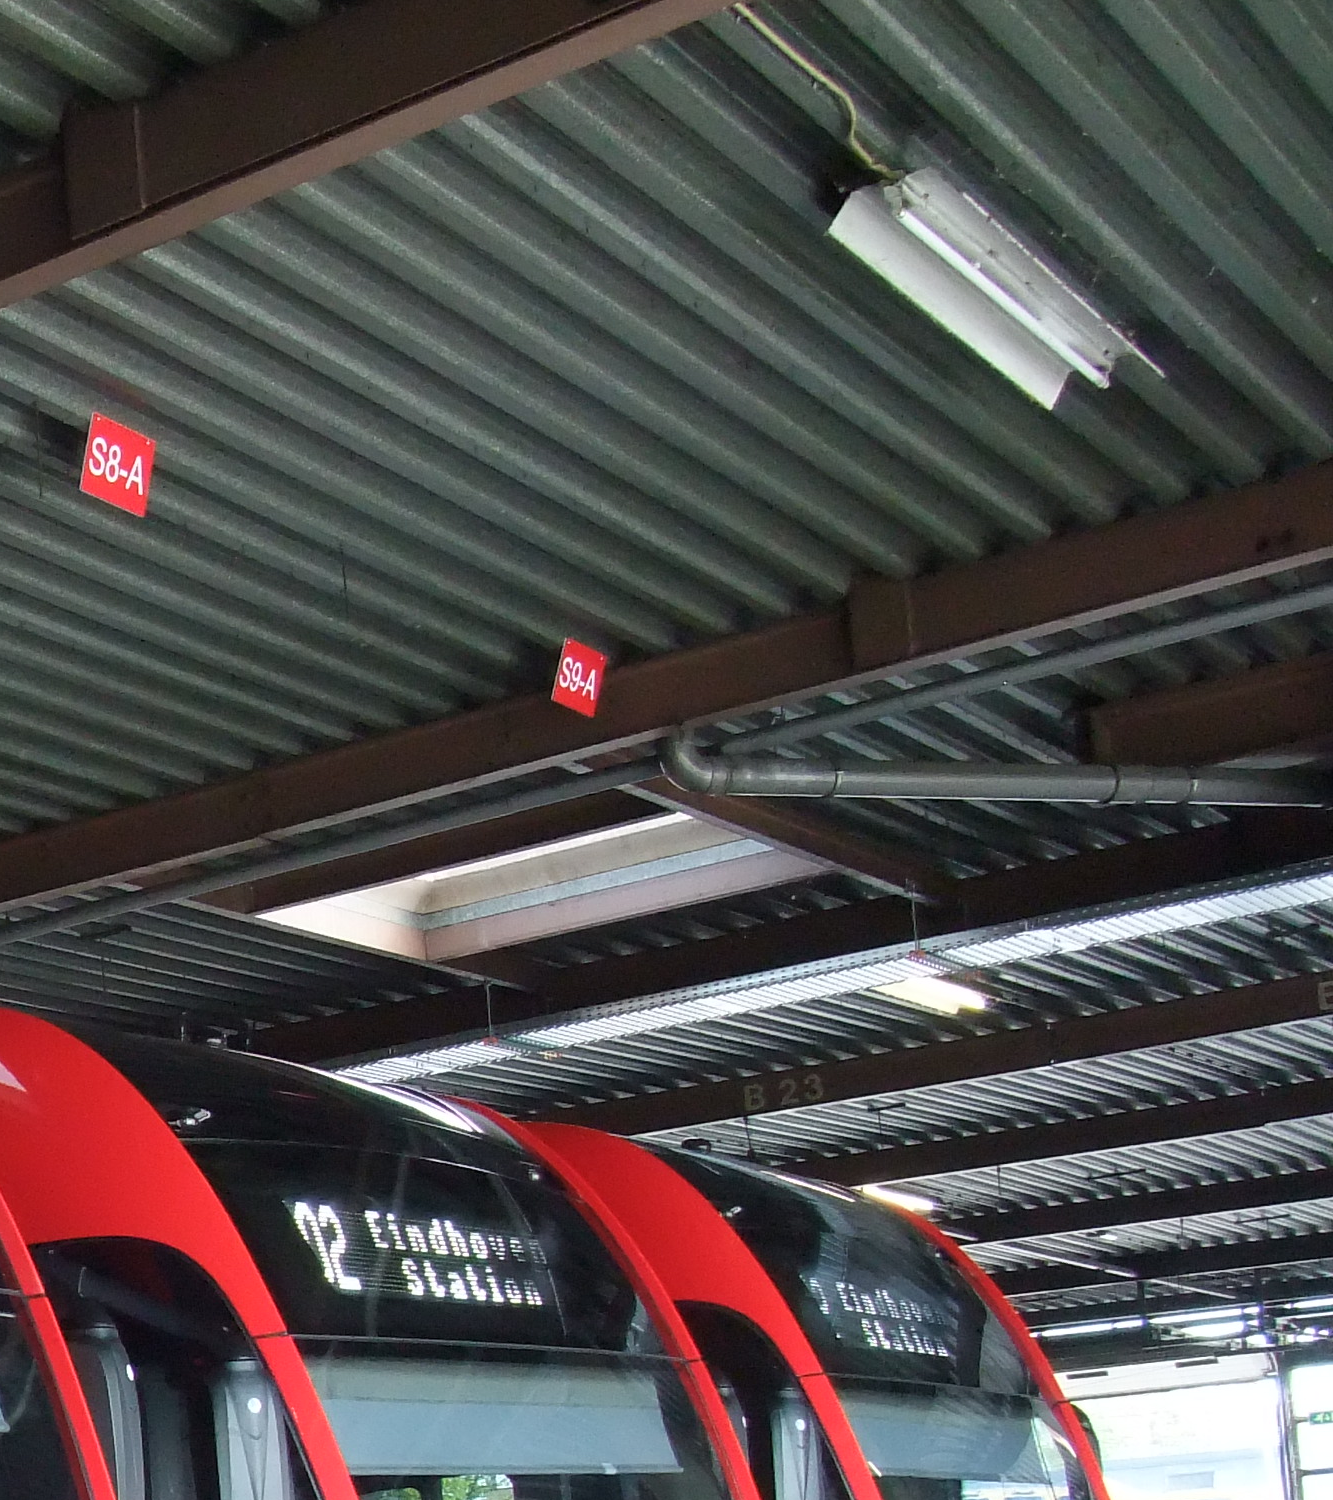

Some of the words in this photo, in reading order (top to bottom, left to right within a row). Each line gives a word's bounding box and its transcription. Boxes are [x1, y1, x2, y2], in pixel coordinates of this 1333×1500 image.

[88, 436, 144, 496] S8-A
[559, 656, 596, 701] S9-A
[779, 1073, 825, 1107] 23
